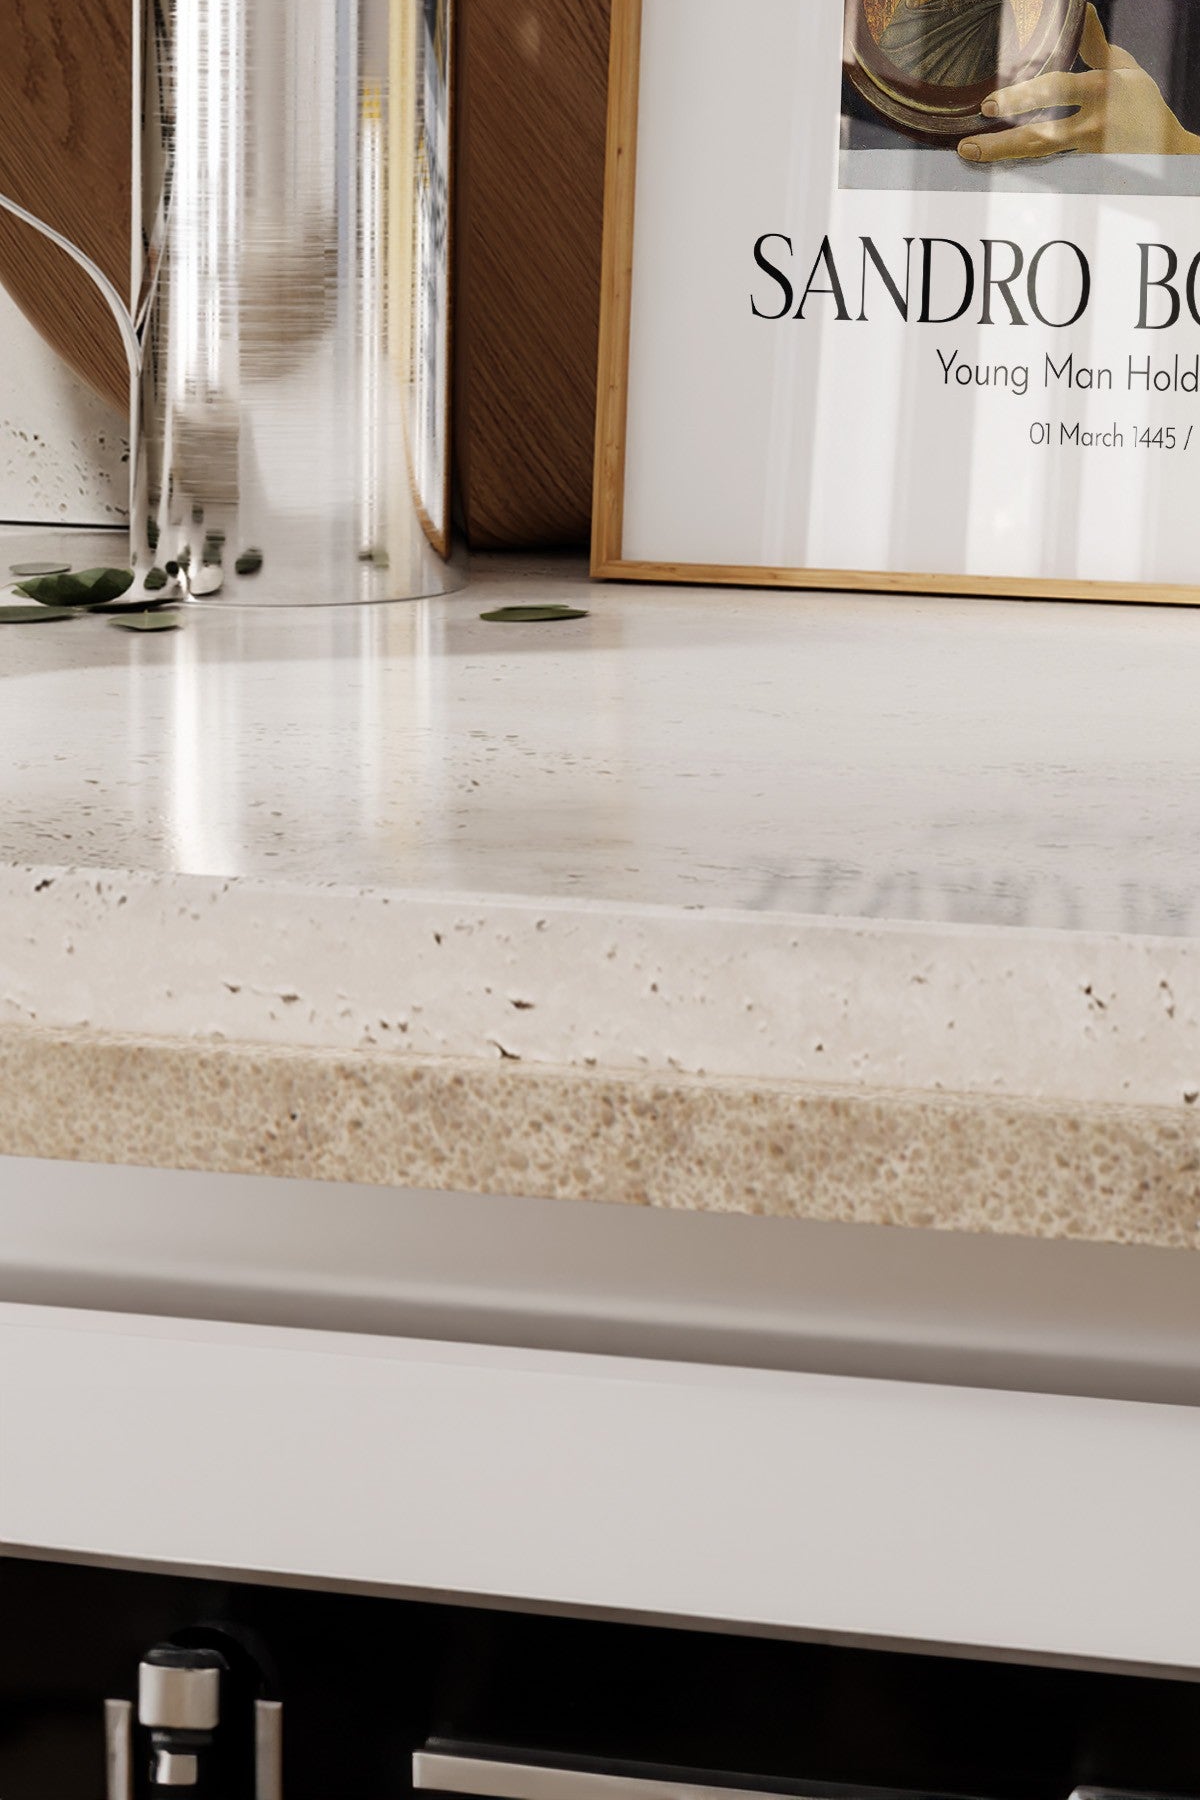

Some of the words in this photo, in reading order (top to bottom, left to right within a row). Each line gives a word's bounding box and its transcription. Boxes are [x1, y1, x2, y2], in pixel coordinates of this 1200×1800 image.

[750, 233, 1092, 328] SANDRO
[936, 348, 1029, 395] Young
[1045, 352, 1113, 390] Man
[1029, 422, 1052, 446] 01
[1058, 422, 1124, 449] March
[1132, 426, 1177, 450] 1445
[1183, 425, 1194, 451] /
